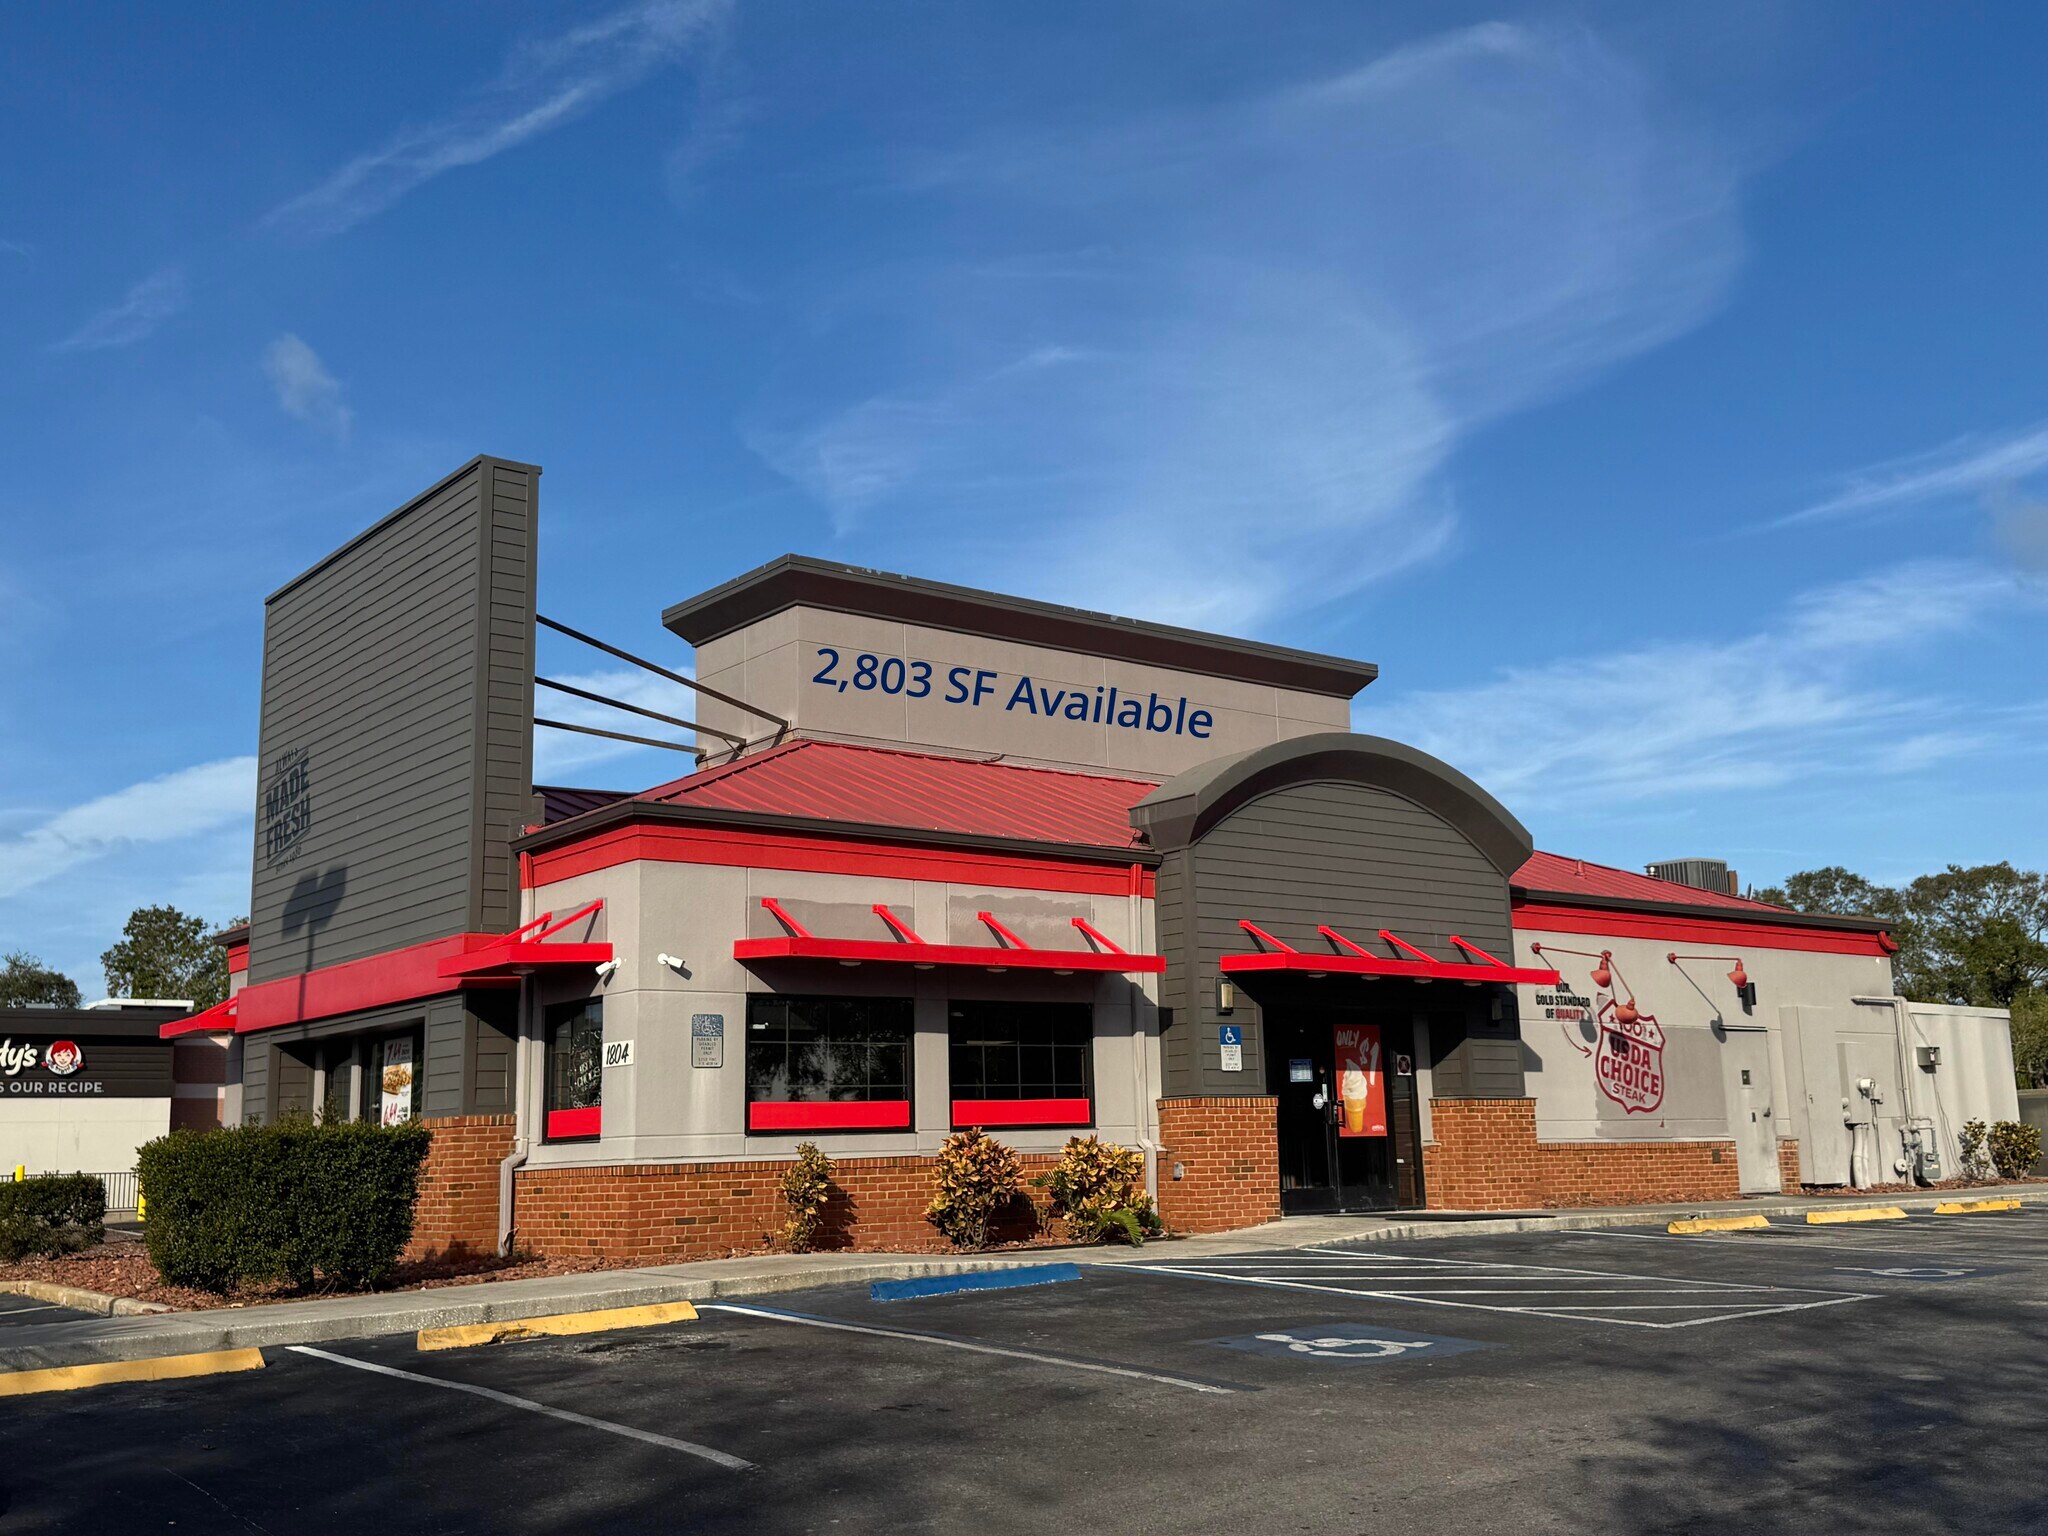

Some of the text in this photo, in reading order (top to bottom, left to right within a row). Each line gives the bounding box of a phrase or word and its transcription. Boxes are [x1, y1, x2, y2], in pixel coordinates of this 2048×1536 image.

[265, 756, 310, 825] MADE
[266, 792, 312, 861] FRESH
[1556, 983, 1571, 993] OUR
[1536, 994, 1591, 1008] GOLD STANDARD
[1545, 1008, 1585, 1020] OF QUALITY
[1336, 1029, 1360, 1048] ONLY
[606, 1042, 629, 1066] 1804
[1610, 1036, 1651, 1070] USDA
[1600, 1055, 1660, 1097] CHOICE
[10, 1082, 44, 1093] OUR
[48, 1082, 103, 1093] RECIPE
[1612, 1082, 1646, 1104] STEAK
